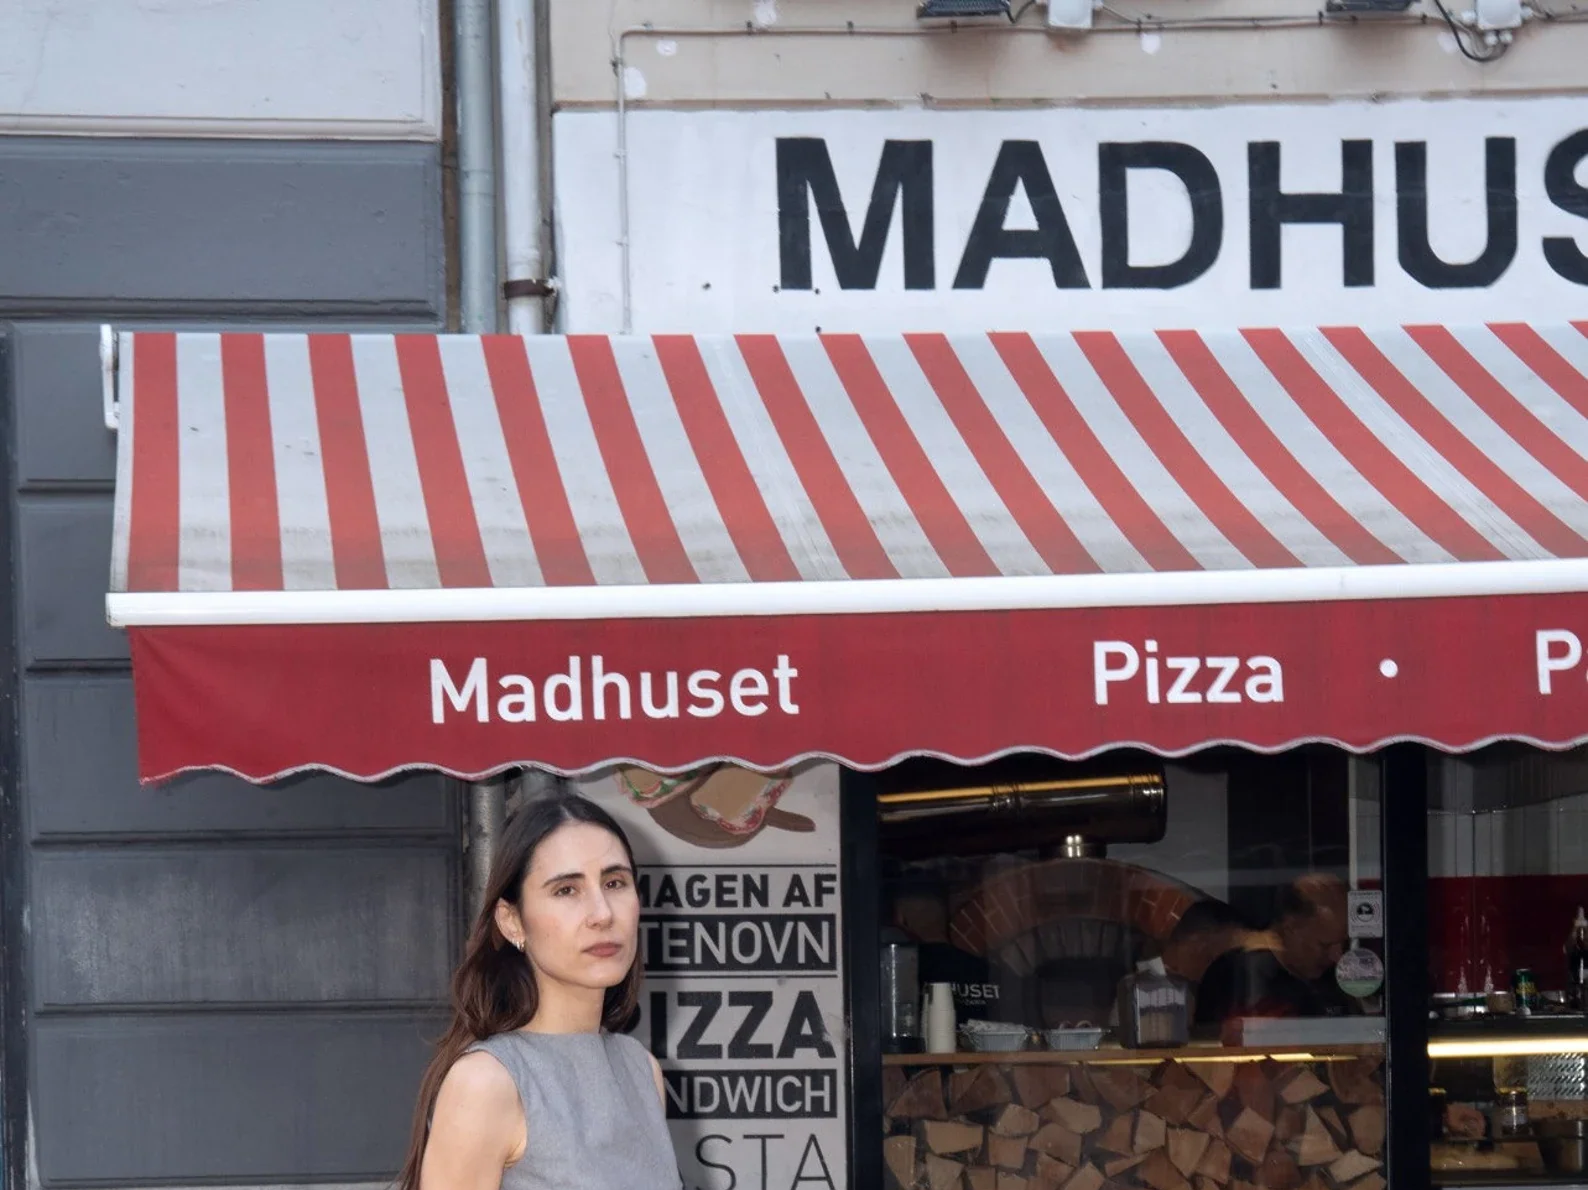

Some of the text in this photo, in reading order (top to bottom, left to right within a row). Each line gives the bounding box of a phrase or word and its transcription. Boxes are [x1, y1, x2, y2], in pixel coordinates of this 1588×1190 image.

[429, 628, 1588, 724] Madhuset Pizza P
[782, 873, 837, 909] AF
[628, 990, 837, 1059] IZZA
